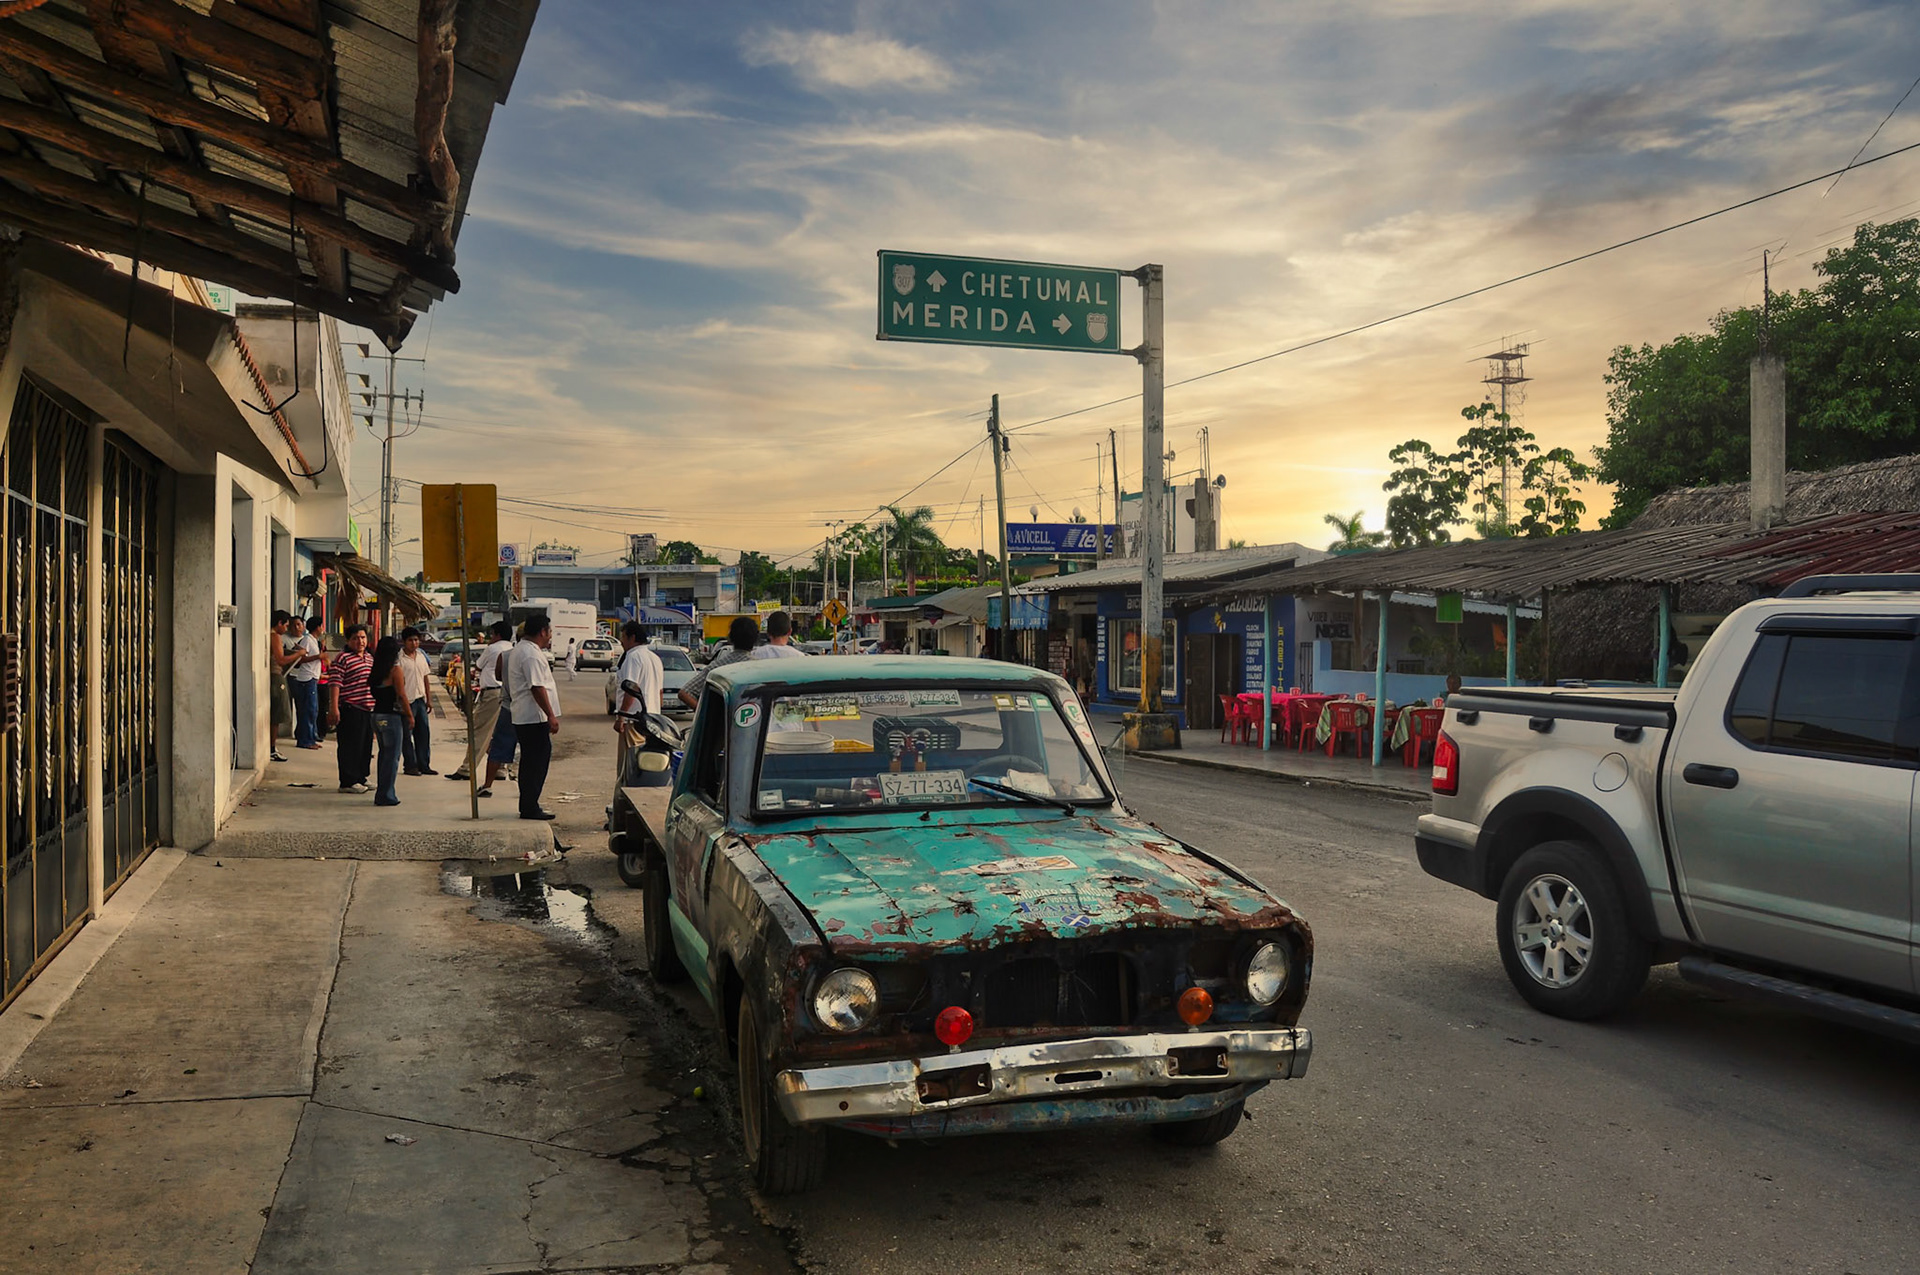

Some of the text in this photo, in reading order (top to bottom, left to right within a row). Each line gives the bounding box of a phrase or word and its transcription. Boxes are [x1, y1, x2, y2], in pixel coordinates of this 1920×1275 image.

[962, 271, 1108, 305] CHETUMAL
[893, 301, 1036, 334] MERIDA
[648, 615, 673, 623] Unión
[815, 705, 843, 713] Borge
[885, 779, 962, 796] SZ-77-334
